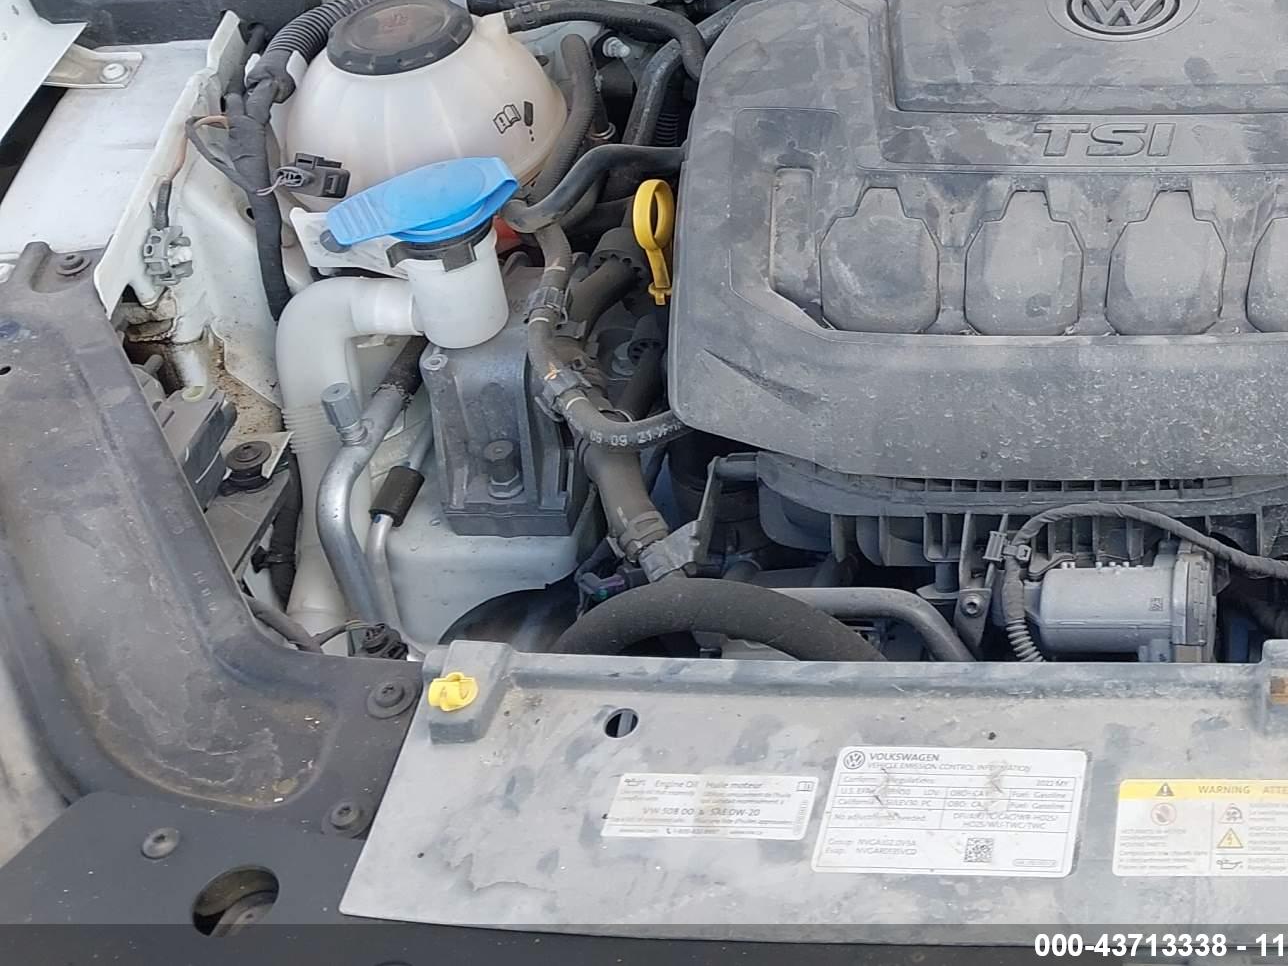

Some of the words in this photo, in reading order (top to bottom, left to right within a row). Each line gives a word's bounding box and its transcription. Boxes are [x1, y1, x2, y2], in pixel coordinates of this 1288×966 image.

[1033, 122, 1176, 157] TSI
[869, 753, 940, 762] VOLKSWAGEN
[1198, 785, 1251, 795] WARNING
